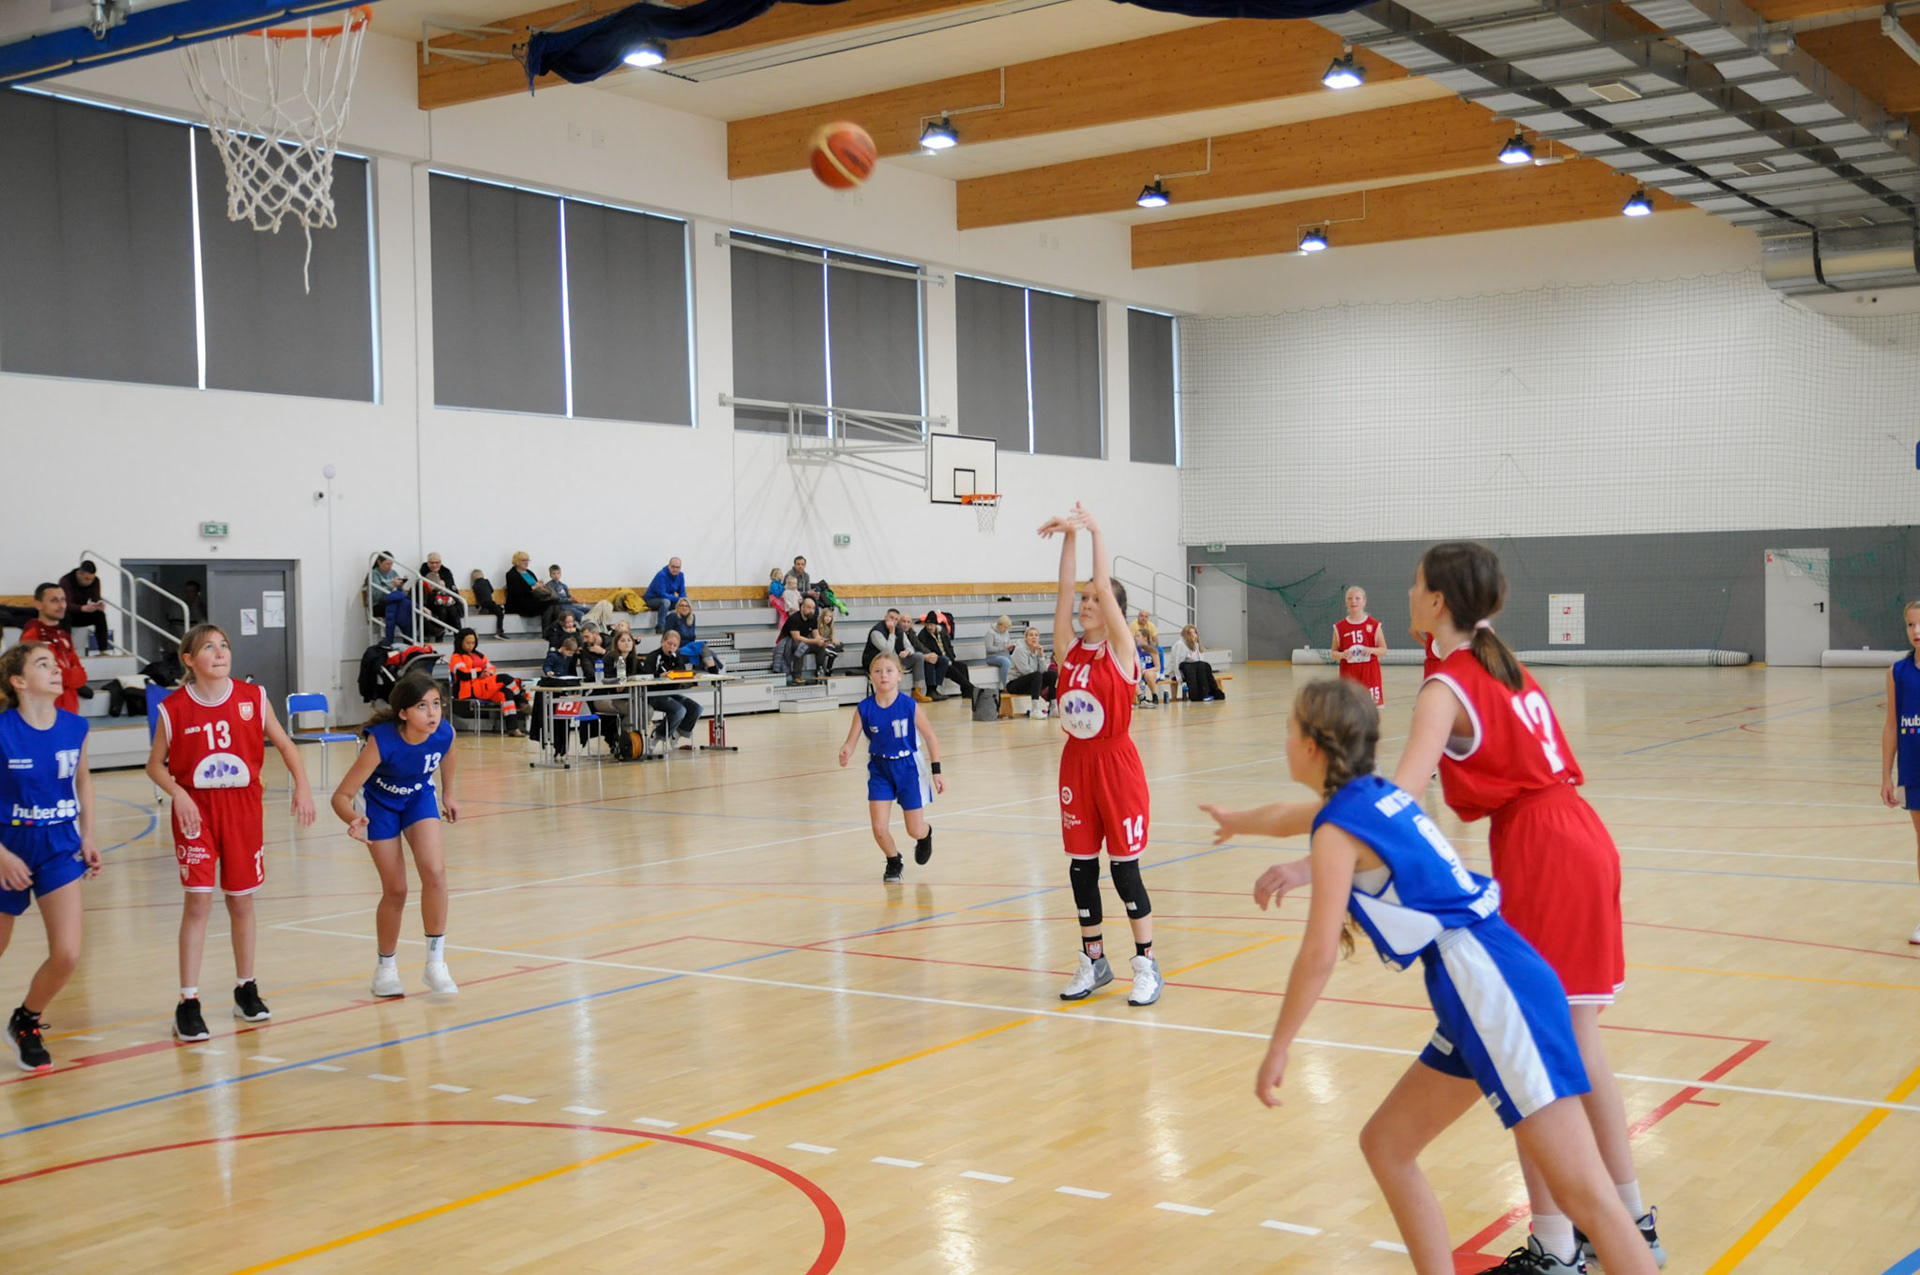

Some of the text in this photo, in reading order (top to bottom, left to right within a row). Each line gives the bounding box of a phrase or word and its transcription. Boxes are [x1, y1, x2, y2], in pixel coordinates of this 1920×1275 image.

[1350, 630, 1363, 643] 15
[1069, 663, 1091, 689] 14
[1369, 686, 1380, 700] 15
[203, 720, 231, 750] 13
[891, 718, 908, 738] 11
[423, 752, 442, 774] 13
[376, 778, 414, 795] huber
[12, 803, 57, 819] huber
[1123, 815, 1144, 845] 14
